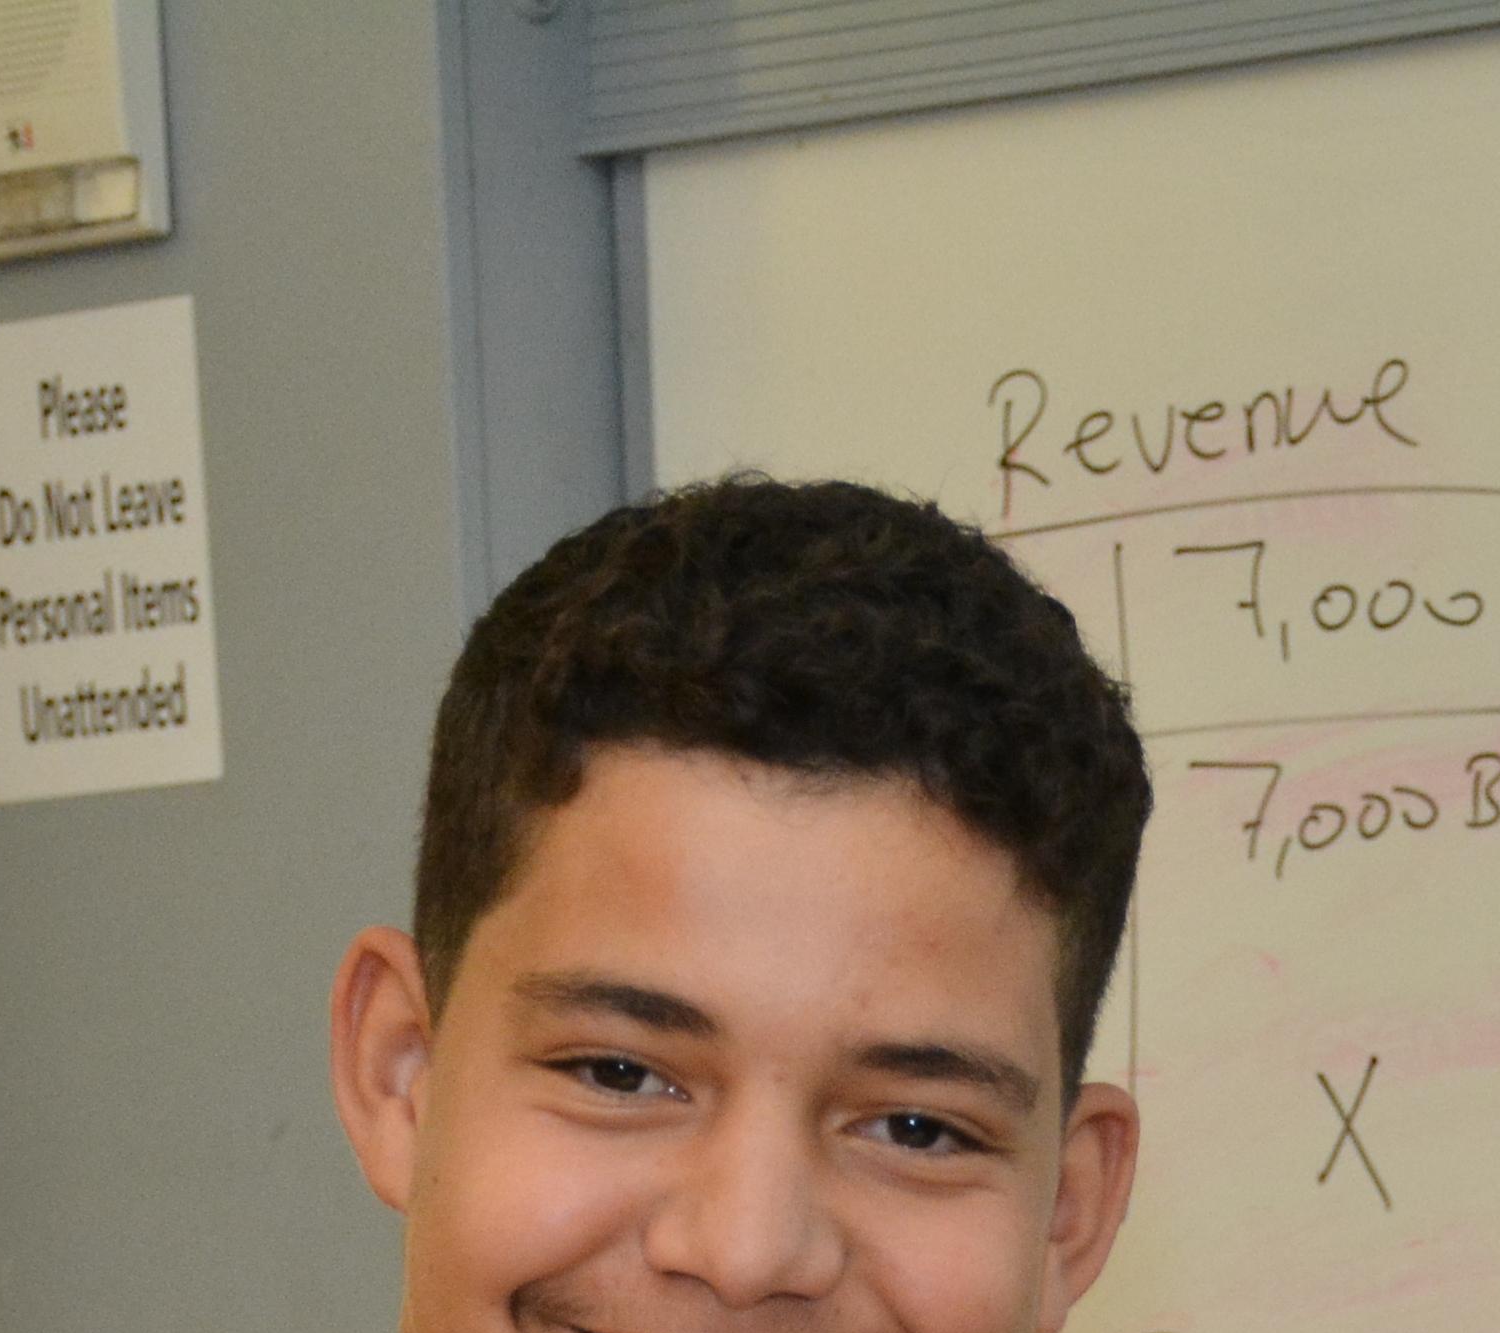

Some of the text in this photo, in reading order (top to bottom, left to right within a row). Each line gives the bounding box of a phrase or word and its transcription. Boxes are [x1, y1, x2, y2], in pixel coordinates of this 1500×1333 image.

[38, 372, 129, 440] Please
[987, 358, 1420, 517] Revenue
[42, 478, 96, 542] Not
[101, 472, 185, 533] Leave
[119, 572, 200, 633] Items
[1175, 539, 1485, 662] 7,000
[18, 659, 187, 743] Unattended
[1188, 760, 1439, 880] 7,000
